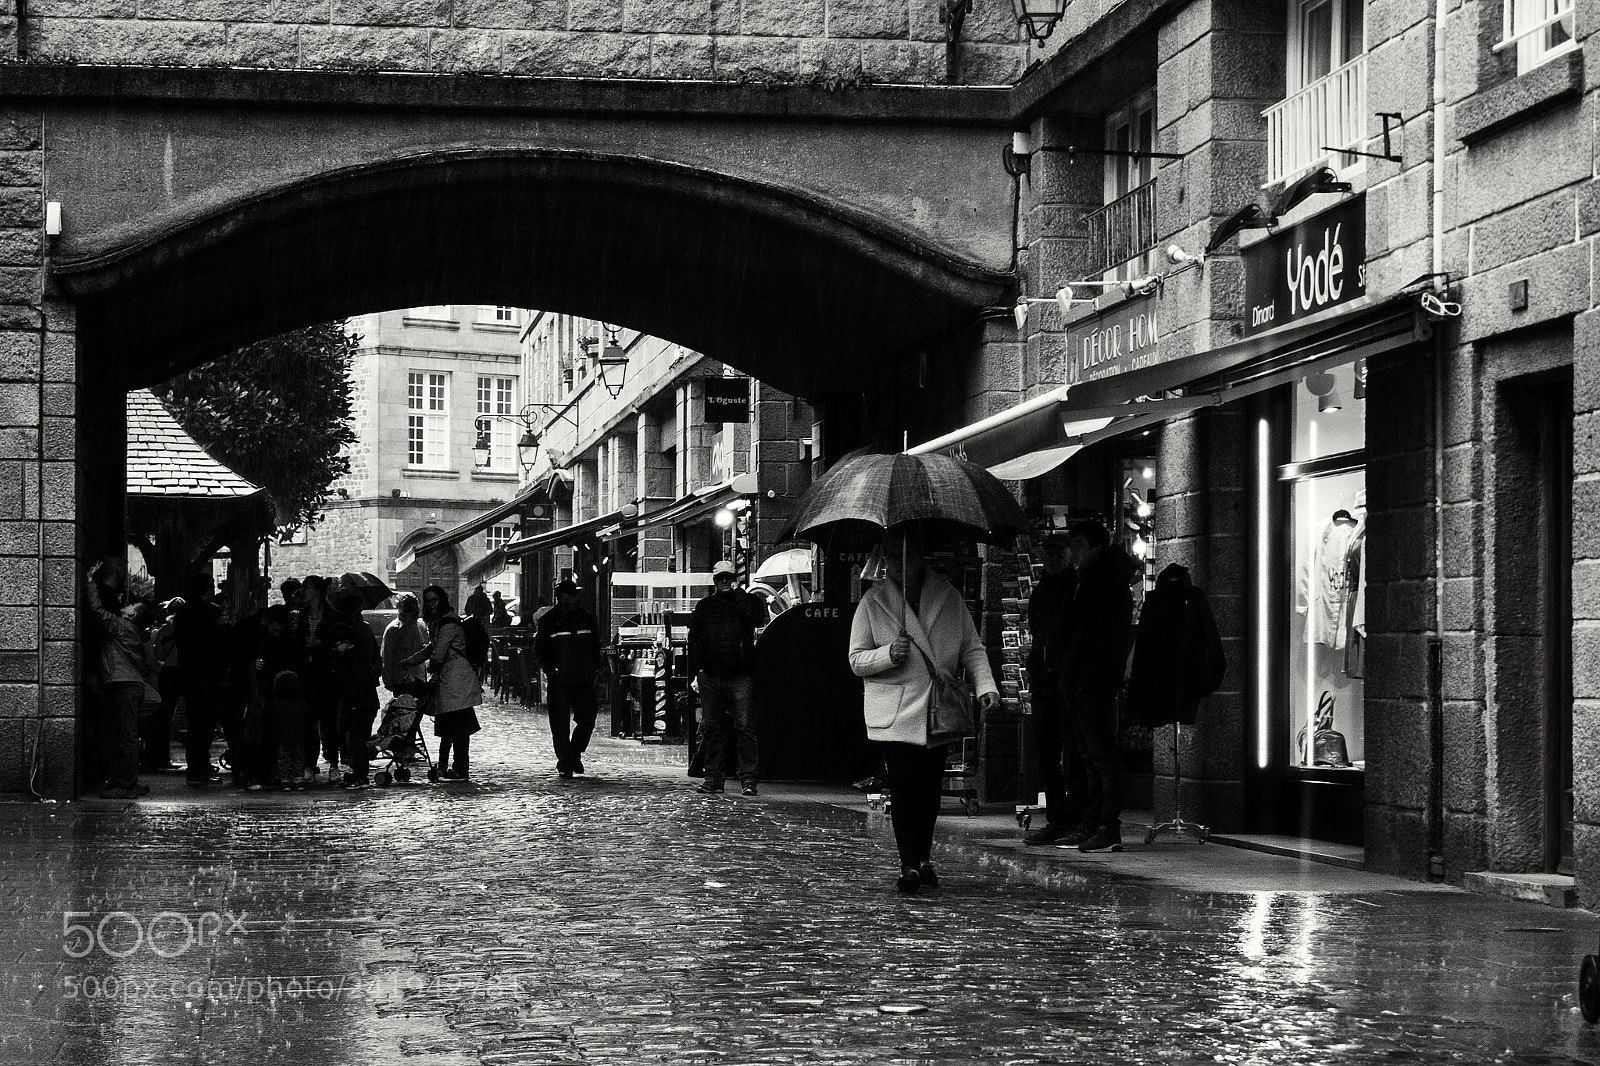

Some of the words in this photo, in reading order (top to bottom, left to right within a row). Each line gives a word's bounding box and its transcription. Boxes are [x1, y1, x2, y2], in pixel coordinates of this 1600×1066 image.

[1286, 222, 1344, 315] Yodé
[1252, 299, 1275, 328] Dinard
[1082, 325, 1122, 370] DÉCOR
[707, 396, 747, 405] L'Oguste
[805, 607, 839, 618] CAFE
